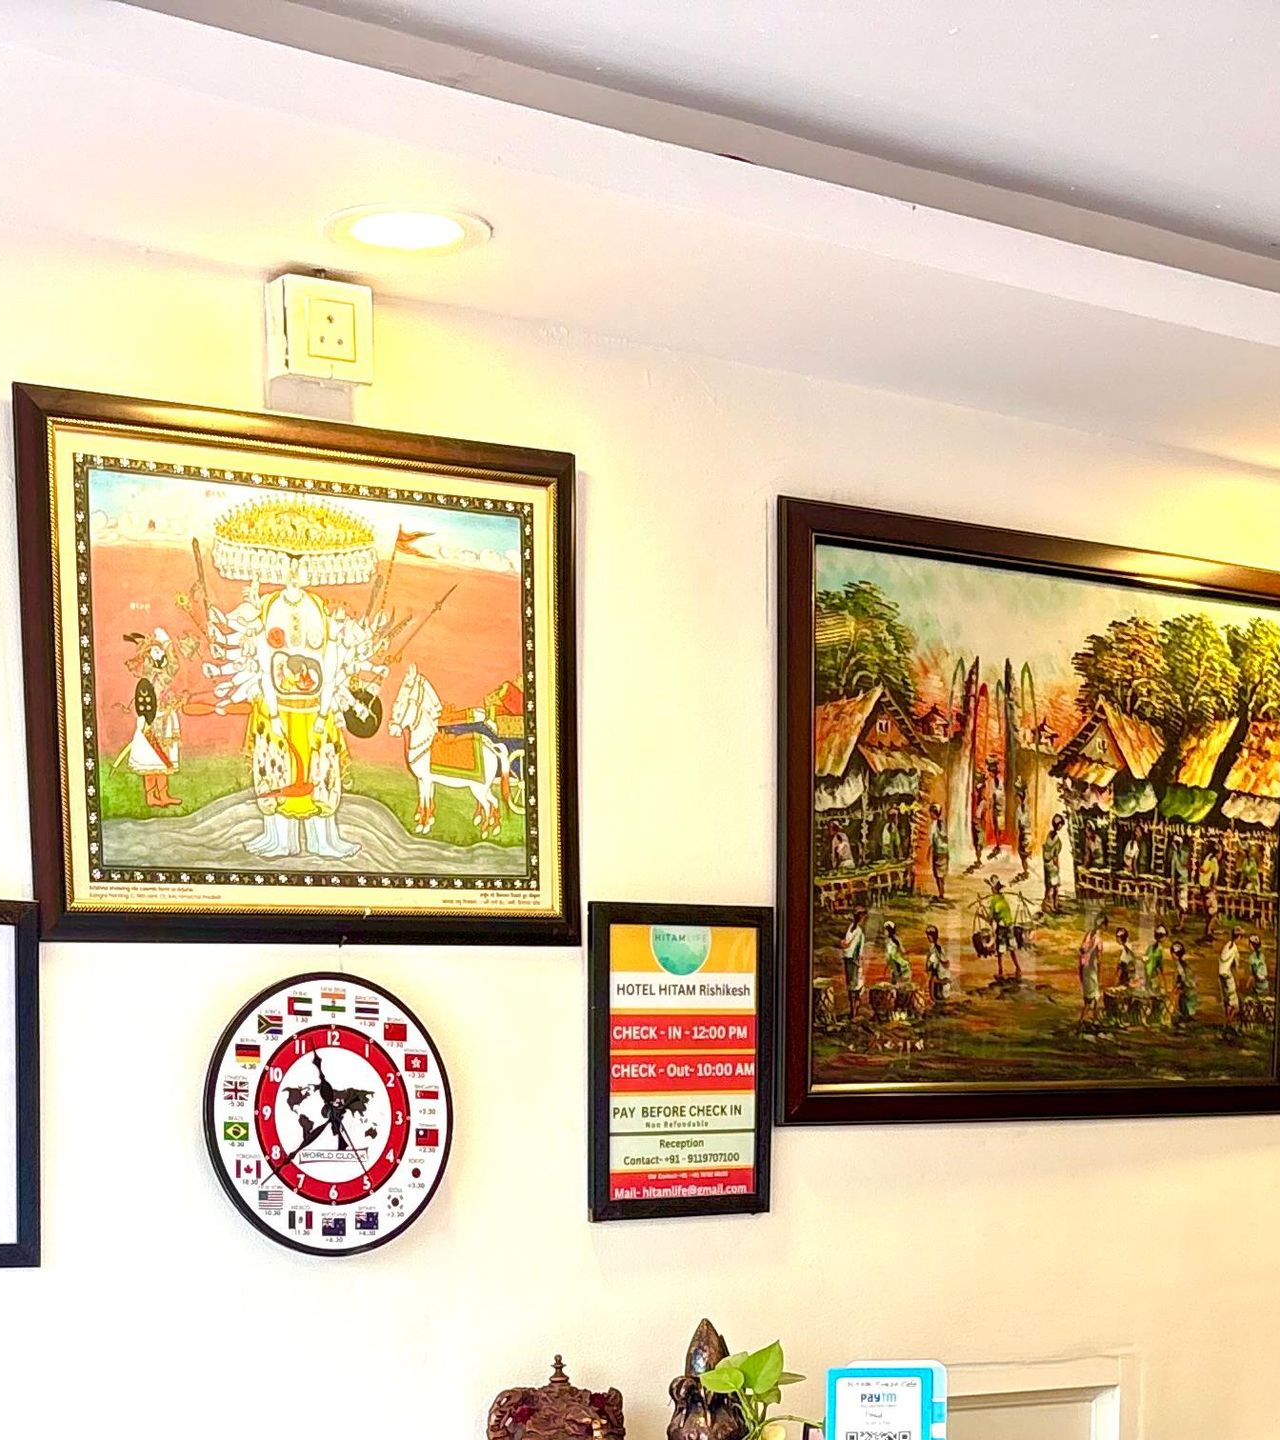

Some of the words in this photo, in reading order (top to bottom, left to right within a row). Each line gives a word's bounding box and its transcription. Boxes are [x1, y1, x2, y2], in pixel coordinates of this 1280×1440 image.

[616, 983, 655, 996] HOTEL
[659, 984, 696, 996] HITAM
[699, 983, 751, 997] Rishikesh
[327, 1031, 340, 1046] 12
[612, 1025, 658, 1040] CHECK
[667, 1026, 682, 1039] IN
[691, 1026, 726, 1039] 12:00
[728, 1026, 748, 1039] PM
[294, 1039, 306, 1055] 11
[364, 1043, 370, 1059] 1
[269, 1066, 283, 1083] 10
[611, 1064, 656, 1078] CHECK
[697, 1062, 732, 1076] 10:00
[734, 1062, 755, 1076] AM
[386, 1072, 395, 1088] 2
[262, 1105, 272, 1121] 9
[395, 1110, 404, 1126] 3
[612, 1106, 636, 1119] PAY
[641, 1105, 686, 1118] BEFORE
[689, 1104, 728, 1117] CHECK
[730, 1104, 742, 1116] IN
[659, 1138, 705, 1150] Reception
[271, 1145, 281, 1160] 8
[302, 1151, 333, 1160] WORLD
[385, 1148, 395, 1164] 4
[664, 1154, 680, 1164] +91
[296, 1173, 305, 1189] 7
[362, 1175, 371, 1191] 5
[329, 1185, 339, 1200] 6
[642, 1184, 748, 1198] hitamlife@gmail.com
